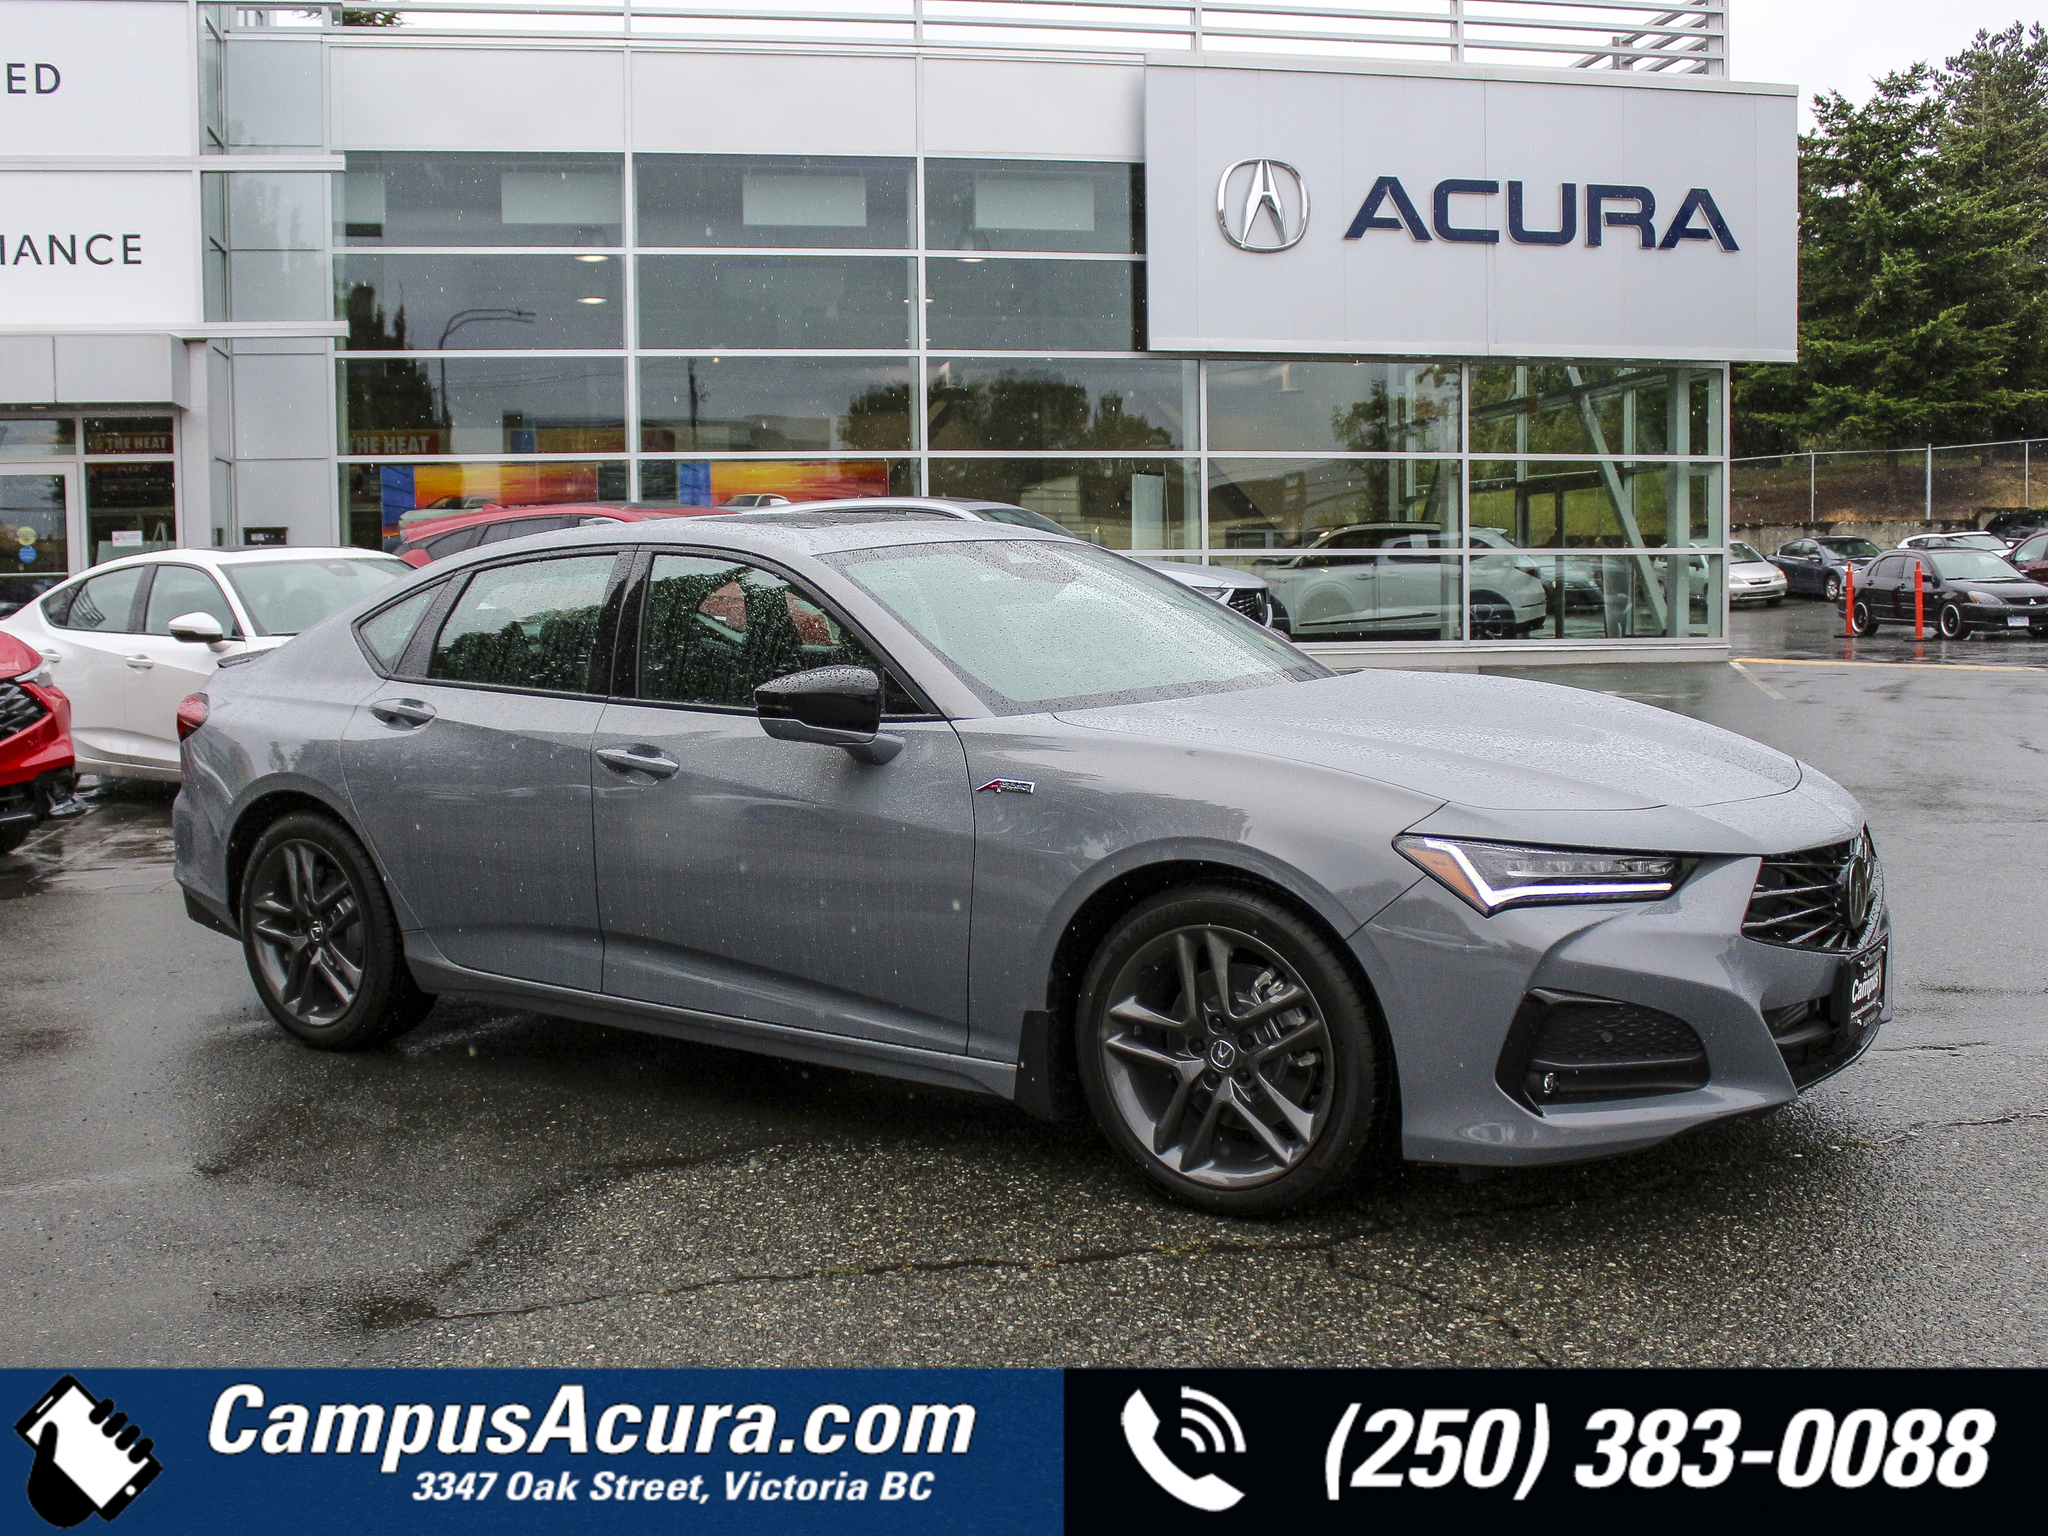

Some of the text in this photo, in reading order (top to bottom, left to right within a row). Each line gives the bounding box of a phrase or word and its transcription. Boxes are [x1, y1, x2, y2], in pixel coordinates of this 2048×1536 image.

[6, 63, 61, 94] ED
[1344, 176, 1740, 253] ACURA
[133, 436, 167, 450] HEAT
[349, 435, 429, 453] THE HEAT
[1852, 971, 1879, 1003] Campus
